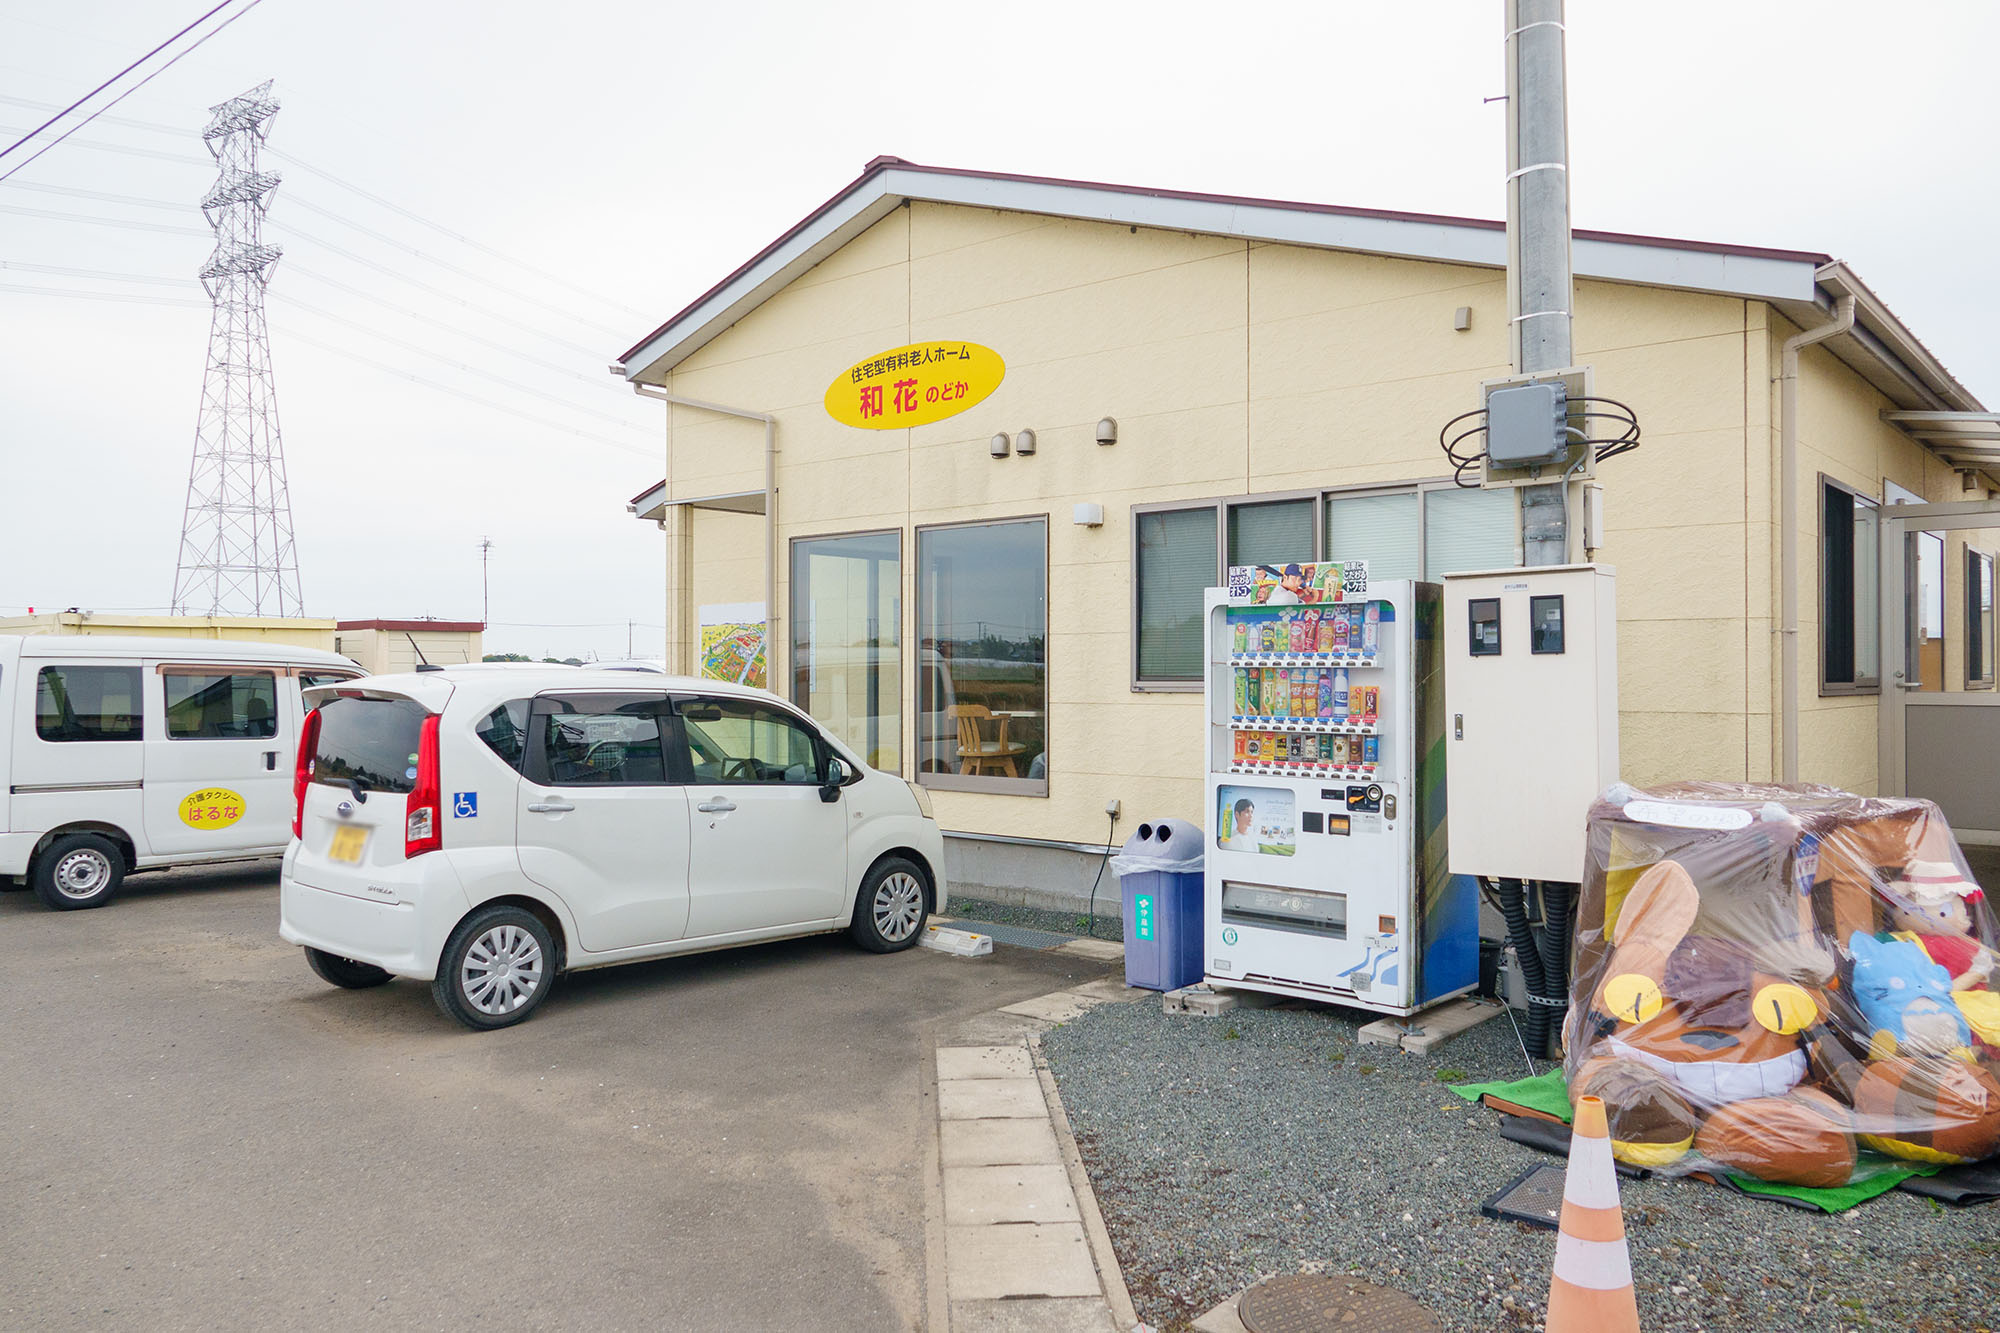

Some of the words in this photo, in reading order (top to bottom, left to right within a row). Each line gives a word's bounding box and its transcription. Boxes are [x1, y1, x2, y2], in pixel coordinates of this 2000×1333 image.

[851, 345, 970, 384] 住宅型有料老人ホーム
[925, 380, 969, 403] のどか
[1347, 581, 1367, 592] トクホ
[187, 792, 238, 805] 介護タクシー
[188, 806, 239, 821] はるな
[1140, 909, 1148, 936] 伊藤園
